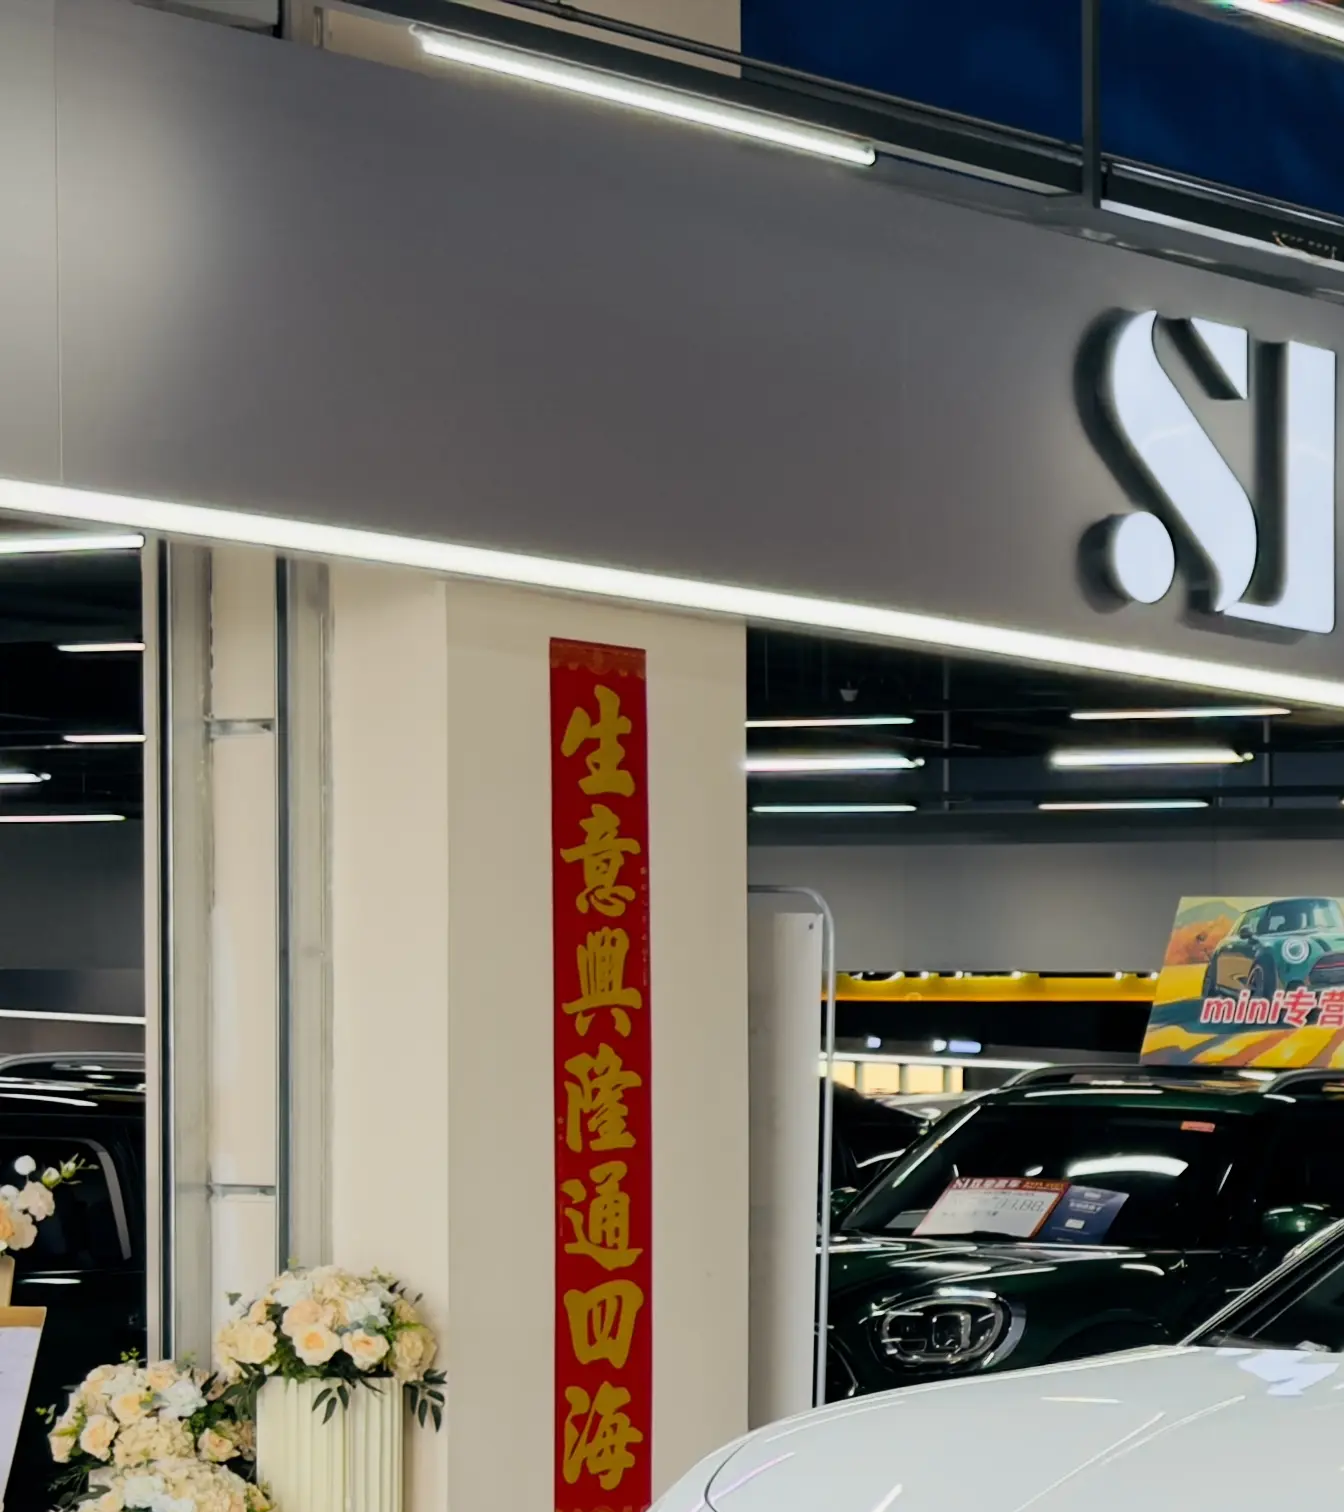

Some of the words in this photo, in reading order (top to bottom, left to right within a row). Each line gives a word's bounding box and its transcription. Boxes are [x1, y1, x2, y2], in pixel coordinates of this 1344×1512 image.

[560, 684, 644, 1491] 生意興隆通四海
